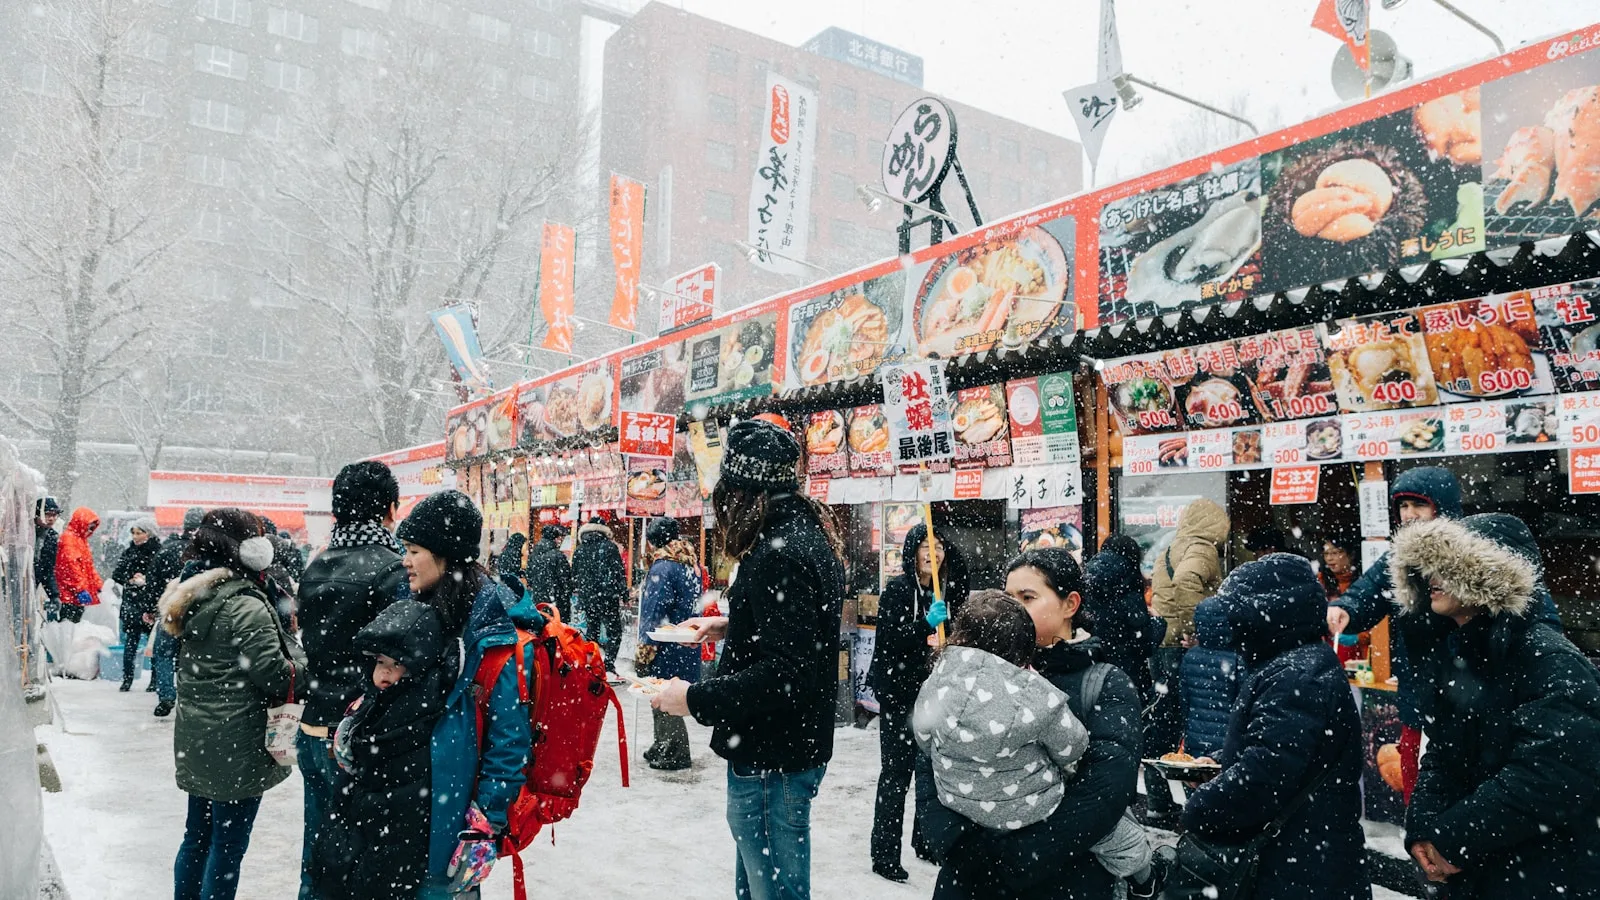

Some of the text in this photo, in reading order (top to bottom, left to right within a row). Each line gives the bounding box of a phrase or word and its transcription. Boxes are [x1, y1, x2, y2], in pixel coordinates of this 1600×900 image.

[848, 39, 908, 73] 北洋銀行
[1106, 184, 1200, 228] あっけし名産
[1201, 275, 1254, 298] 蒸しかき
[1425, 300, 1530, 334] 蒸しうに
[1241, 330, 1320, 362] 焼かに足
[961, 388, 987, 401] ラーメン
[627, 412, 670, 428] ラーメン
[1348, 415, 1395, 431] つぶ串
[1450, 404, 1501, 422] 焼つぶ
[1572, 424, 1600, 444] 50
[899, 432, 951, 461] 最後尾
[1276, 469, 1316, 486] ご注文
